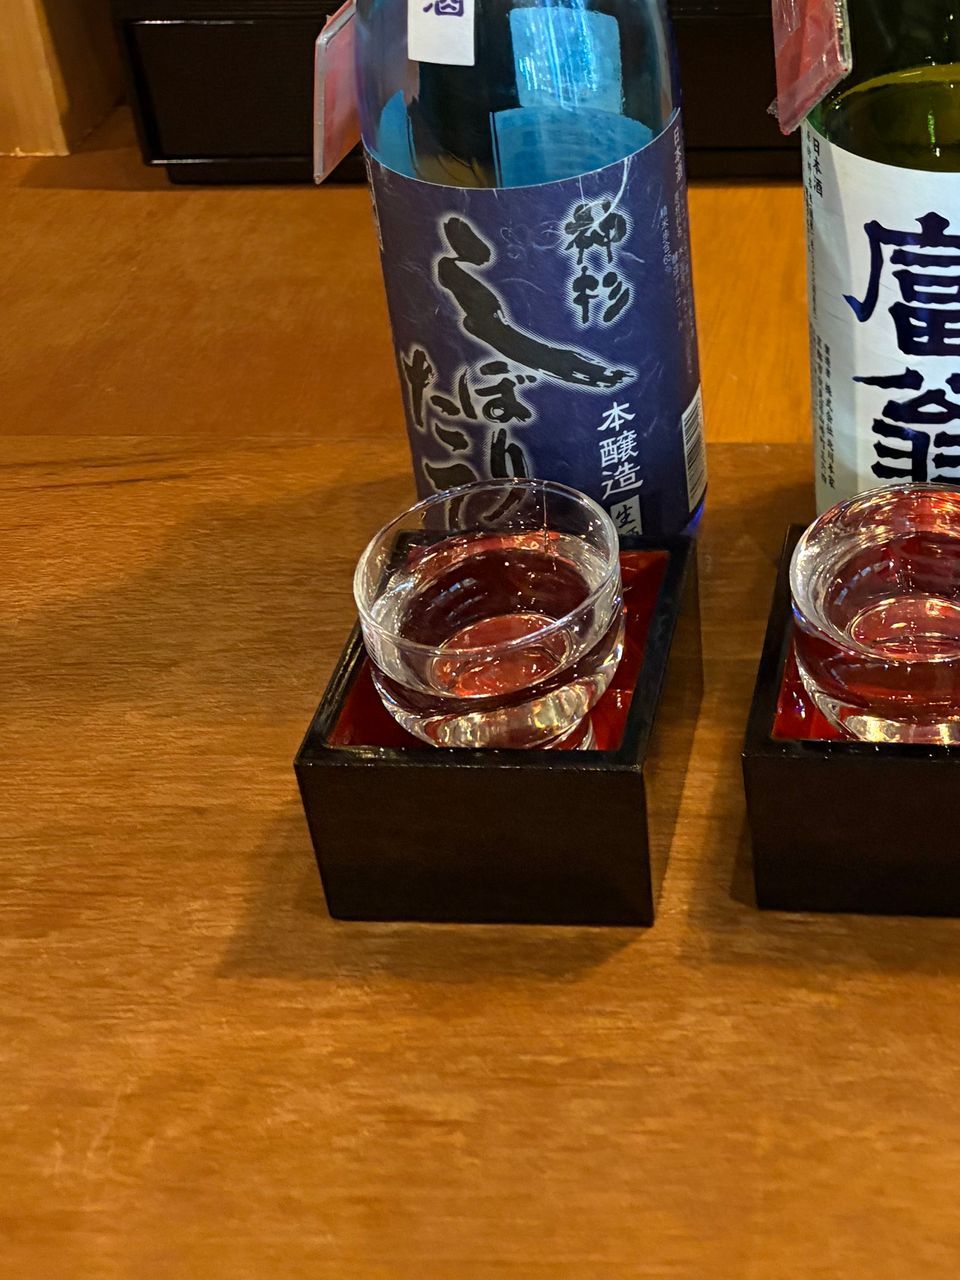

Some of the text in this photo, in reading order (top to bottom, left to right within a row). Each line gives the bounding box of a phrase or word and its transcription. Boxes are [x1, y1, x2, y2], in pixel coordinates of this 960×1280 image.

[813, 136, 824, 199] 日本酒
[597, 401, 644, 500] 本醸造
[616, 504, 640, 535] 生
